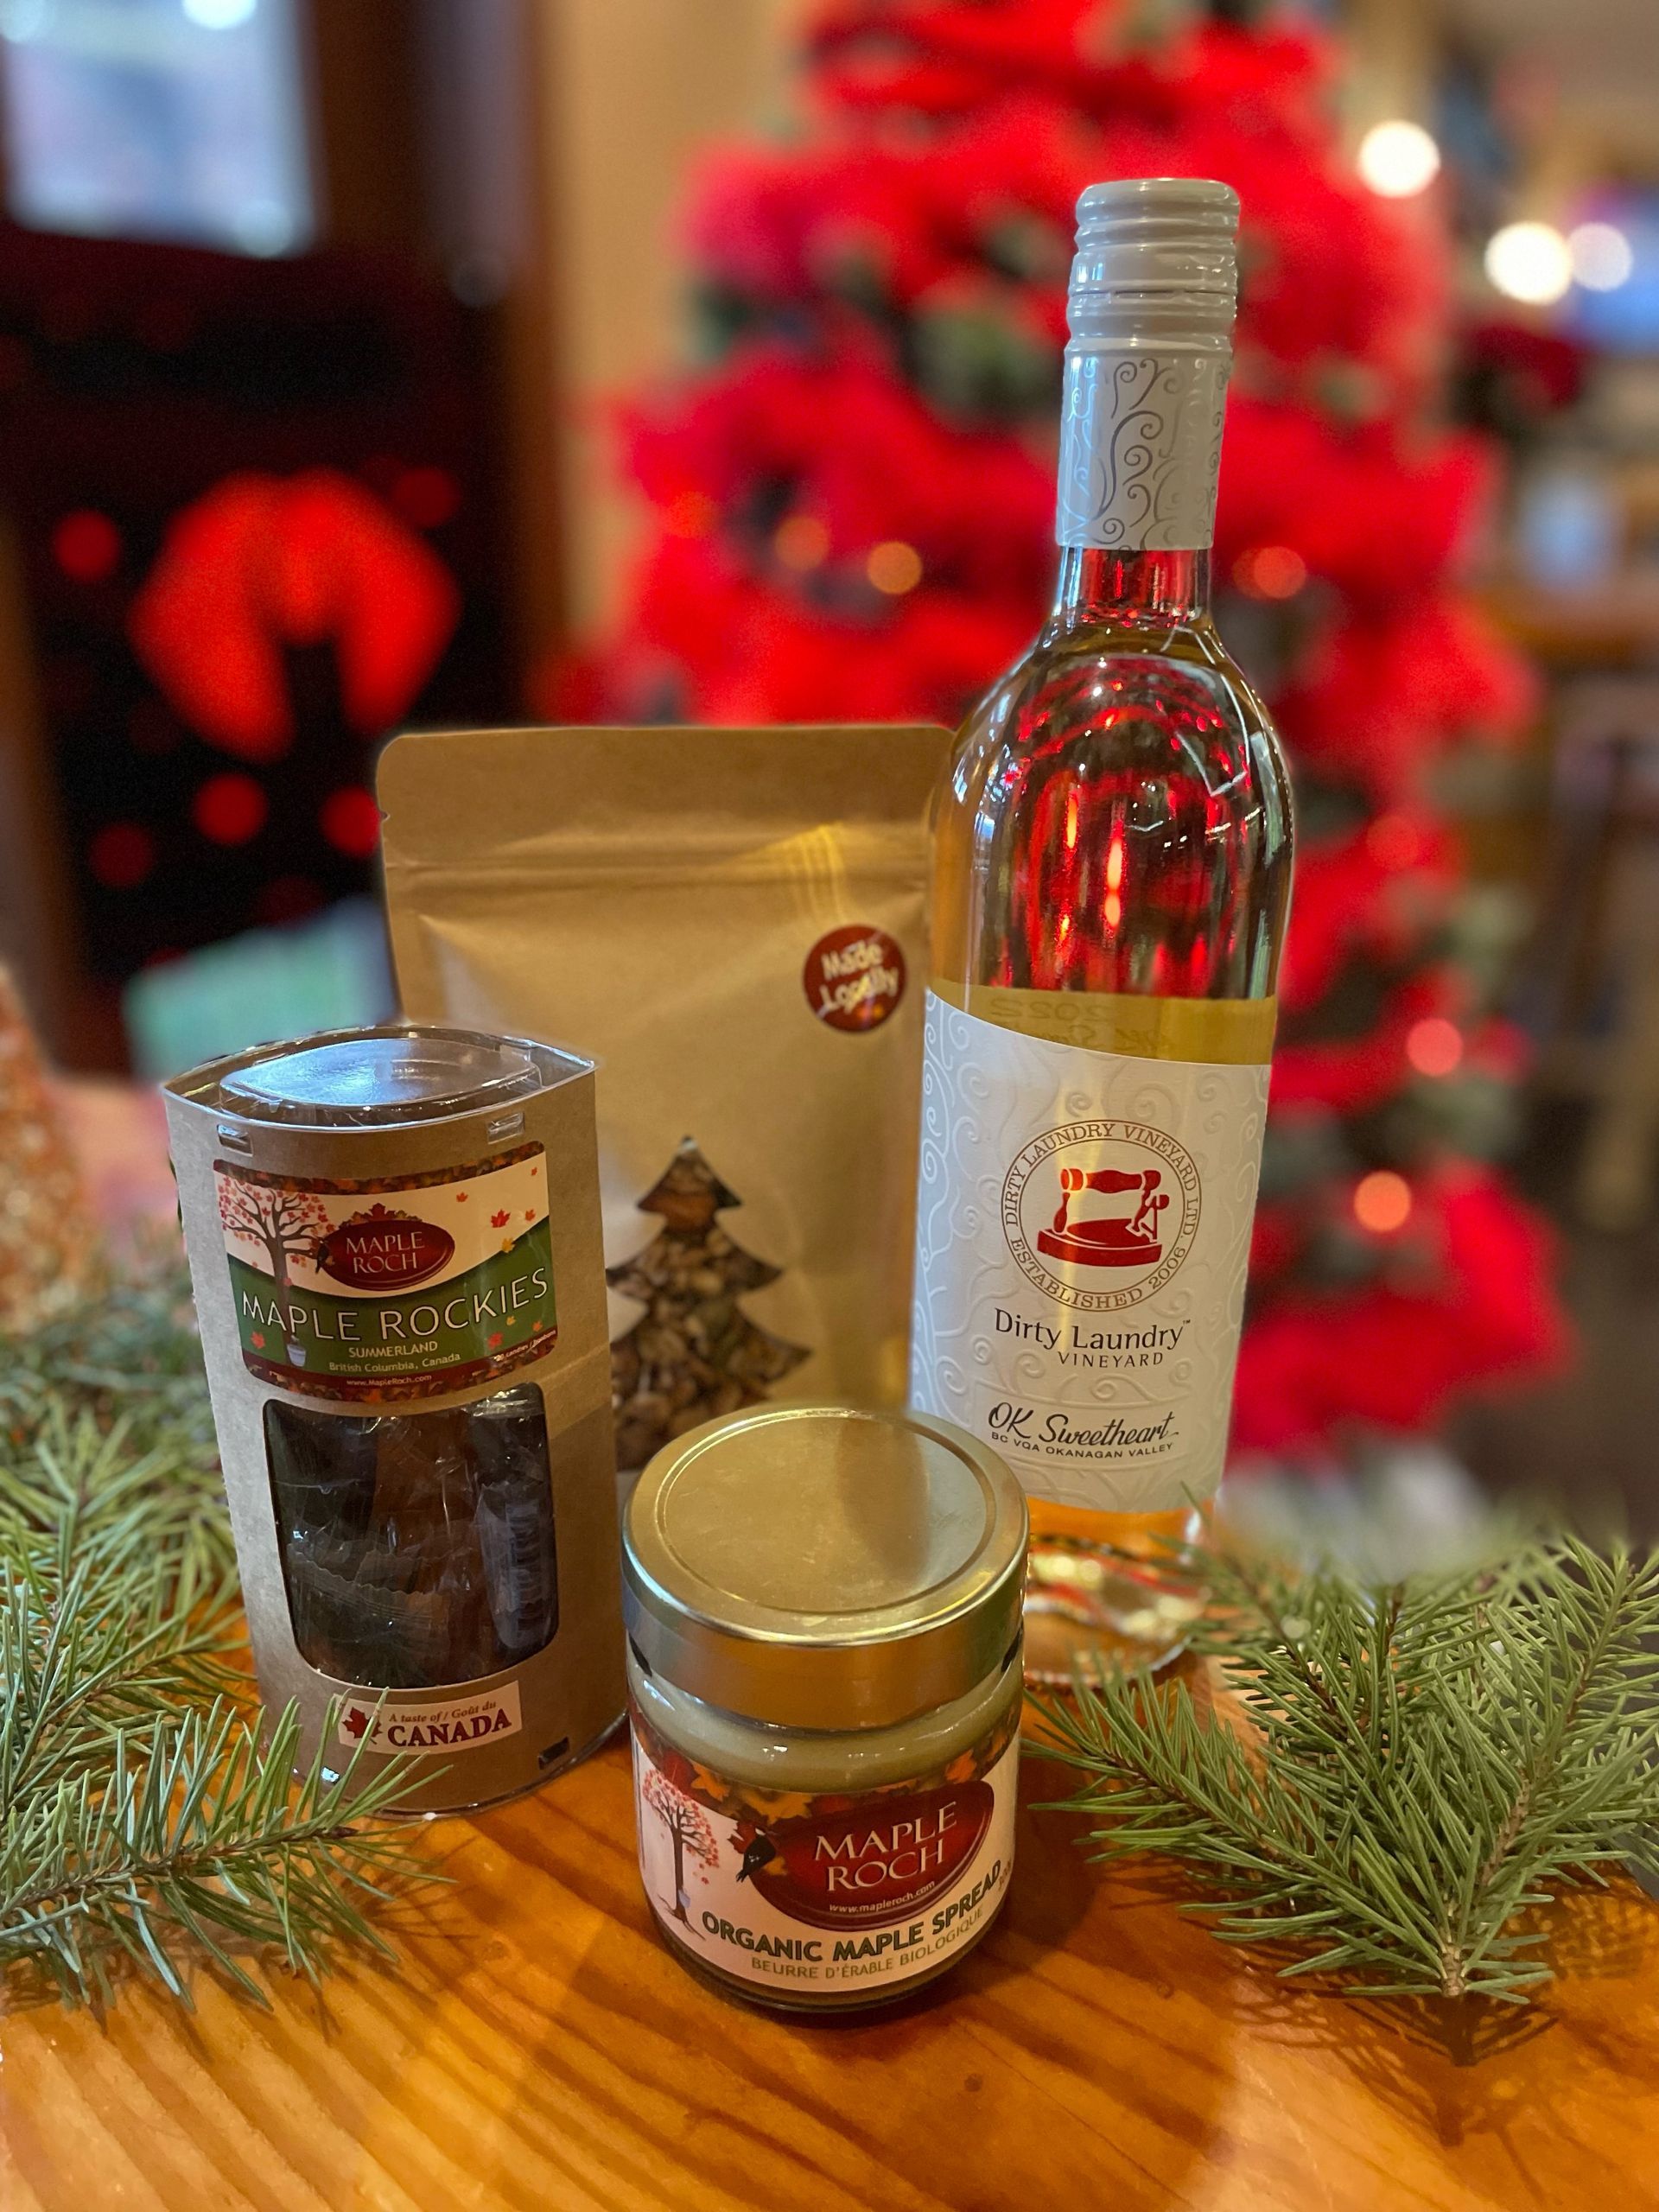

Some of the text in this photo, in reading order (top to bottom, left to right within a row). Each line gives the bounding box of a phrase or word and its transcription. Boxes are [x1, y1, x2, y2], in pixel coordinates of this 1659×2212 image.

[1006, 1168, 1027, 1227] DIRTY
[1025, 1123, 1116, 1168] LAUNDRY
[1124, 1125, 1198, 1198] VINEYARD
[346, 1231, 425, 1257] MAPLE
[353, 1255, 418, 1274] ROCH
[1010, 1237, 1186, 1310] ESTABLISHED 2006
[242, 1267, 548, 1342] MAPLE ROCKIES
[995, 1308, 1061, 1350] Dirty
[329, 1353, 461, 1372] British Columbia, Canada
[348, 1341, 438, 1358] SUMMERLAND
[1058, 1351, 1164, 1368] VINEYARD
[988, 1402, 1179, 1446] OK Sweetheart
[991, 1431, 1173, 1459] BC VQA OKANAGAN VALLEY
[388, 1708, 512, 1747] CANADA
[389, 1713, 397, 1722] A
[401, 1713, 427, 1723] taste
[429, 1711, 442, 1726] of
[451, 1704, 480, 1719] Goût
[482, 1700, 497, 1712] du
[814, 1801, 957, 1862] MAPLE
[827, 1842, 947, 1892] ROCH
[702, 1910, 823, 1961] ORGANIC
[832, 1922, 925, 1962] MAPLE
[931, 1859, 1001, 1935] SPREAD
[829, 1879, 936, 1914] www.mapleroch.com
[752, 1906, 984, 1980] BEURRE D'ÉRABLE BIOLOGIQUE
